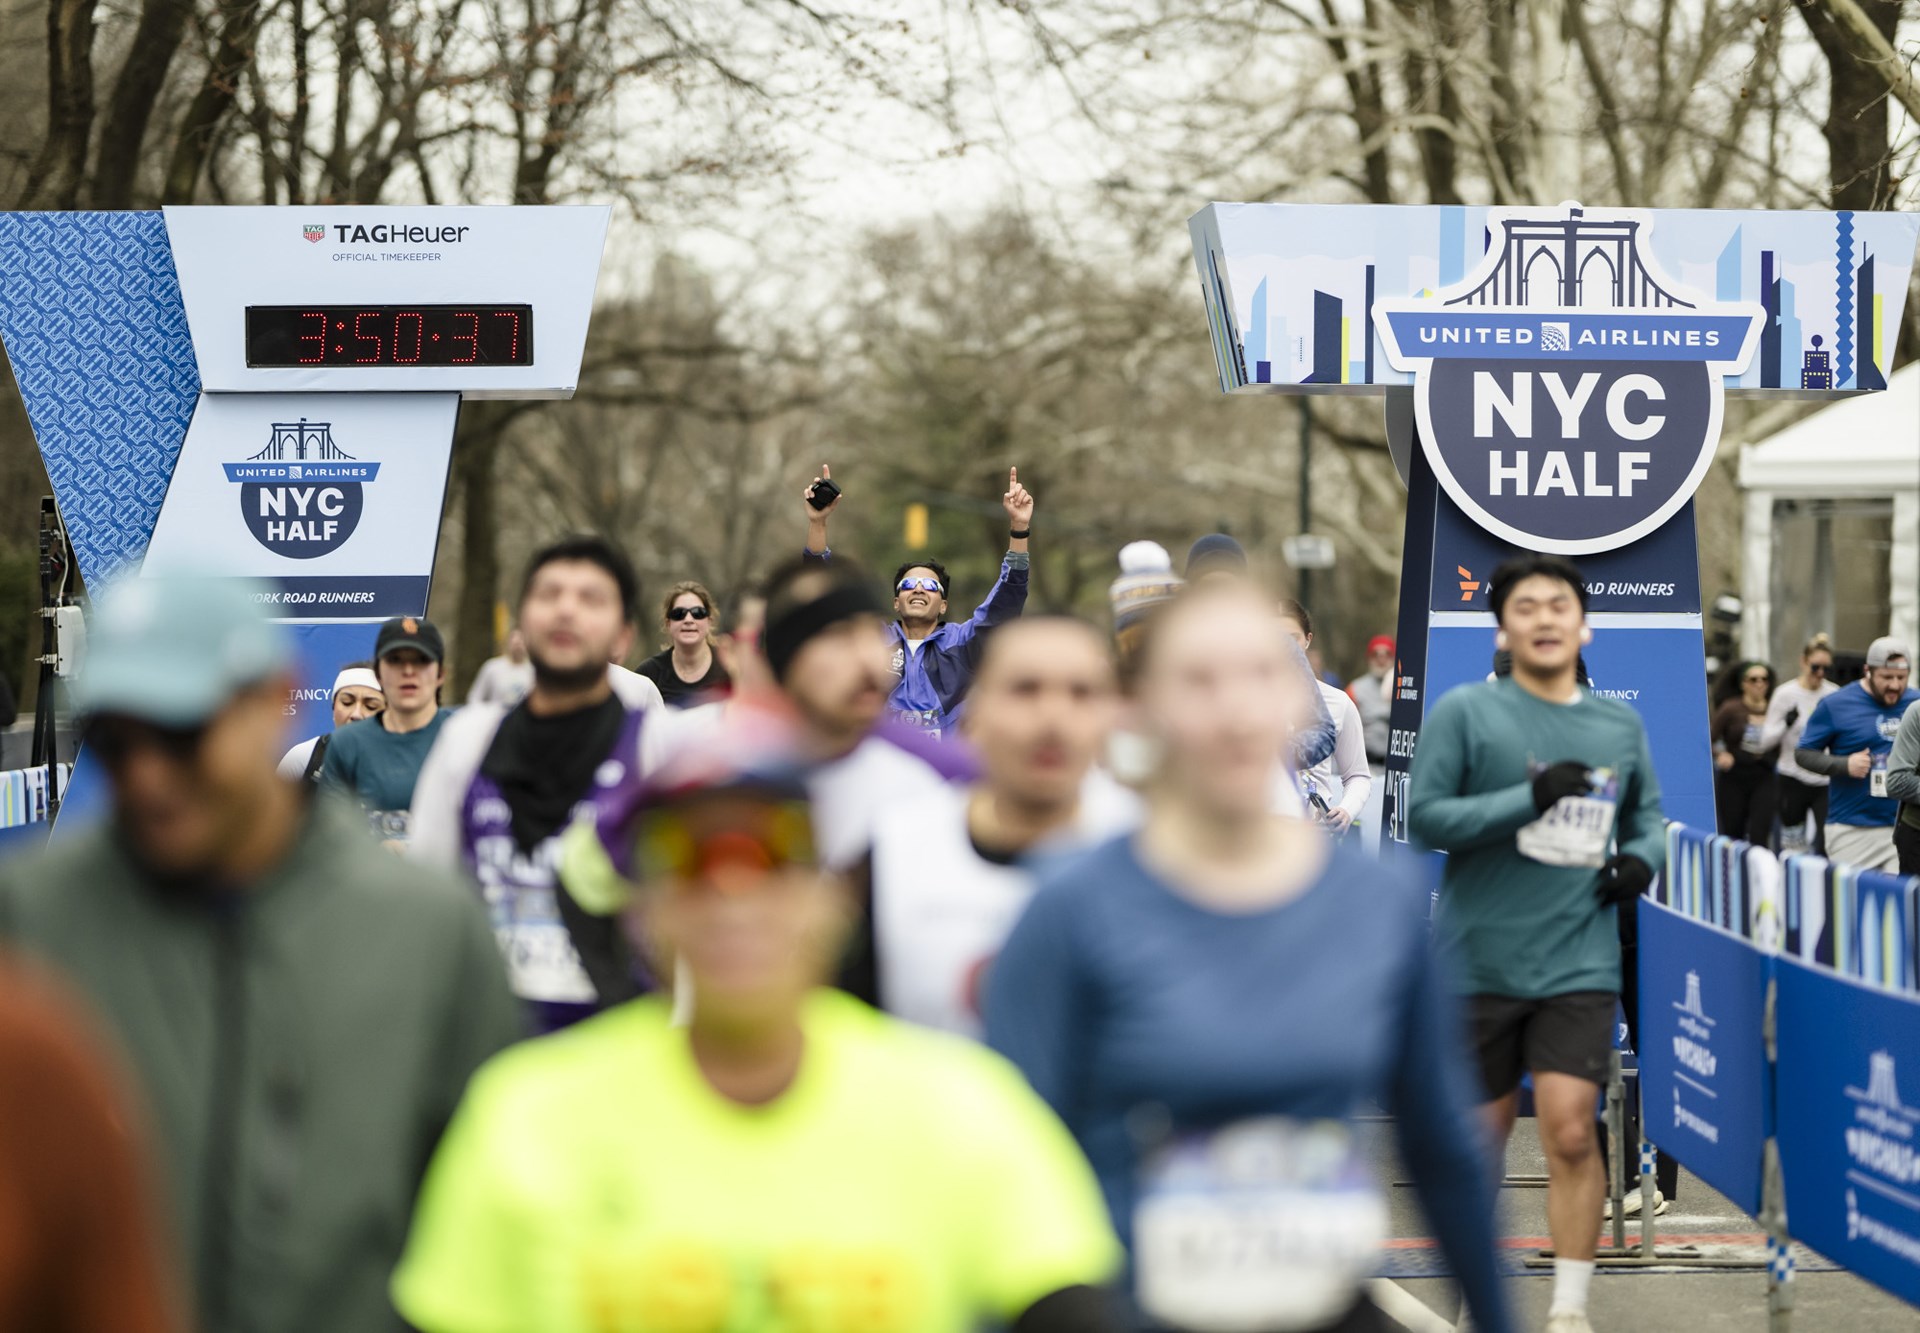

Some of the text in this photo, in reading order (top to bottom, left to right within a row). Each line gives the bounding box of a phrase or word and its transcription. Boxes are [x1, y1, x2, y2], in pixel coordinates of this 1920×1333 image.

[332, 252, 441, 262] OFFICIAL TIMEKEEPER
[1419, 327, 1720, 347] UNITED AIRLINES
[1473, 371, 1667, 441] NYC
[236, 468, 368, 477] UNITED AIRLINES
[1489, 450, 1651, 497] HALF
[259, 487, 345, 517] NYC
[267, 521, 339, 541] HALF
[282, 592, 317, 604] ROAD
[318, 592, 376, 604] RUNNERS
[1607, 582, 1676, 596] RUNNERS
[288, 688, 332, 701] TANCY
[1590, 689, 1640, 701] ULTANCY
[1390, 729, 1416, 758] BELIEVE
[1386, 769, 1395, 796] IN
